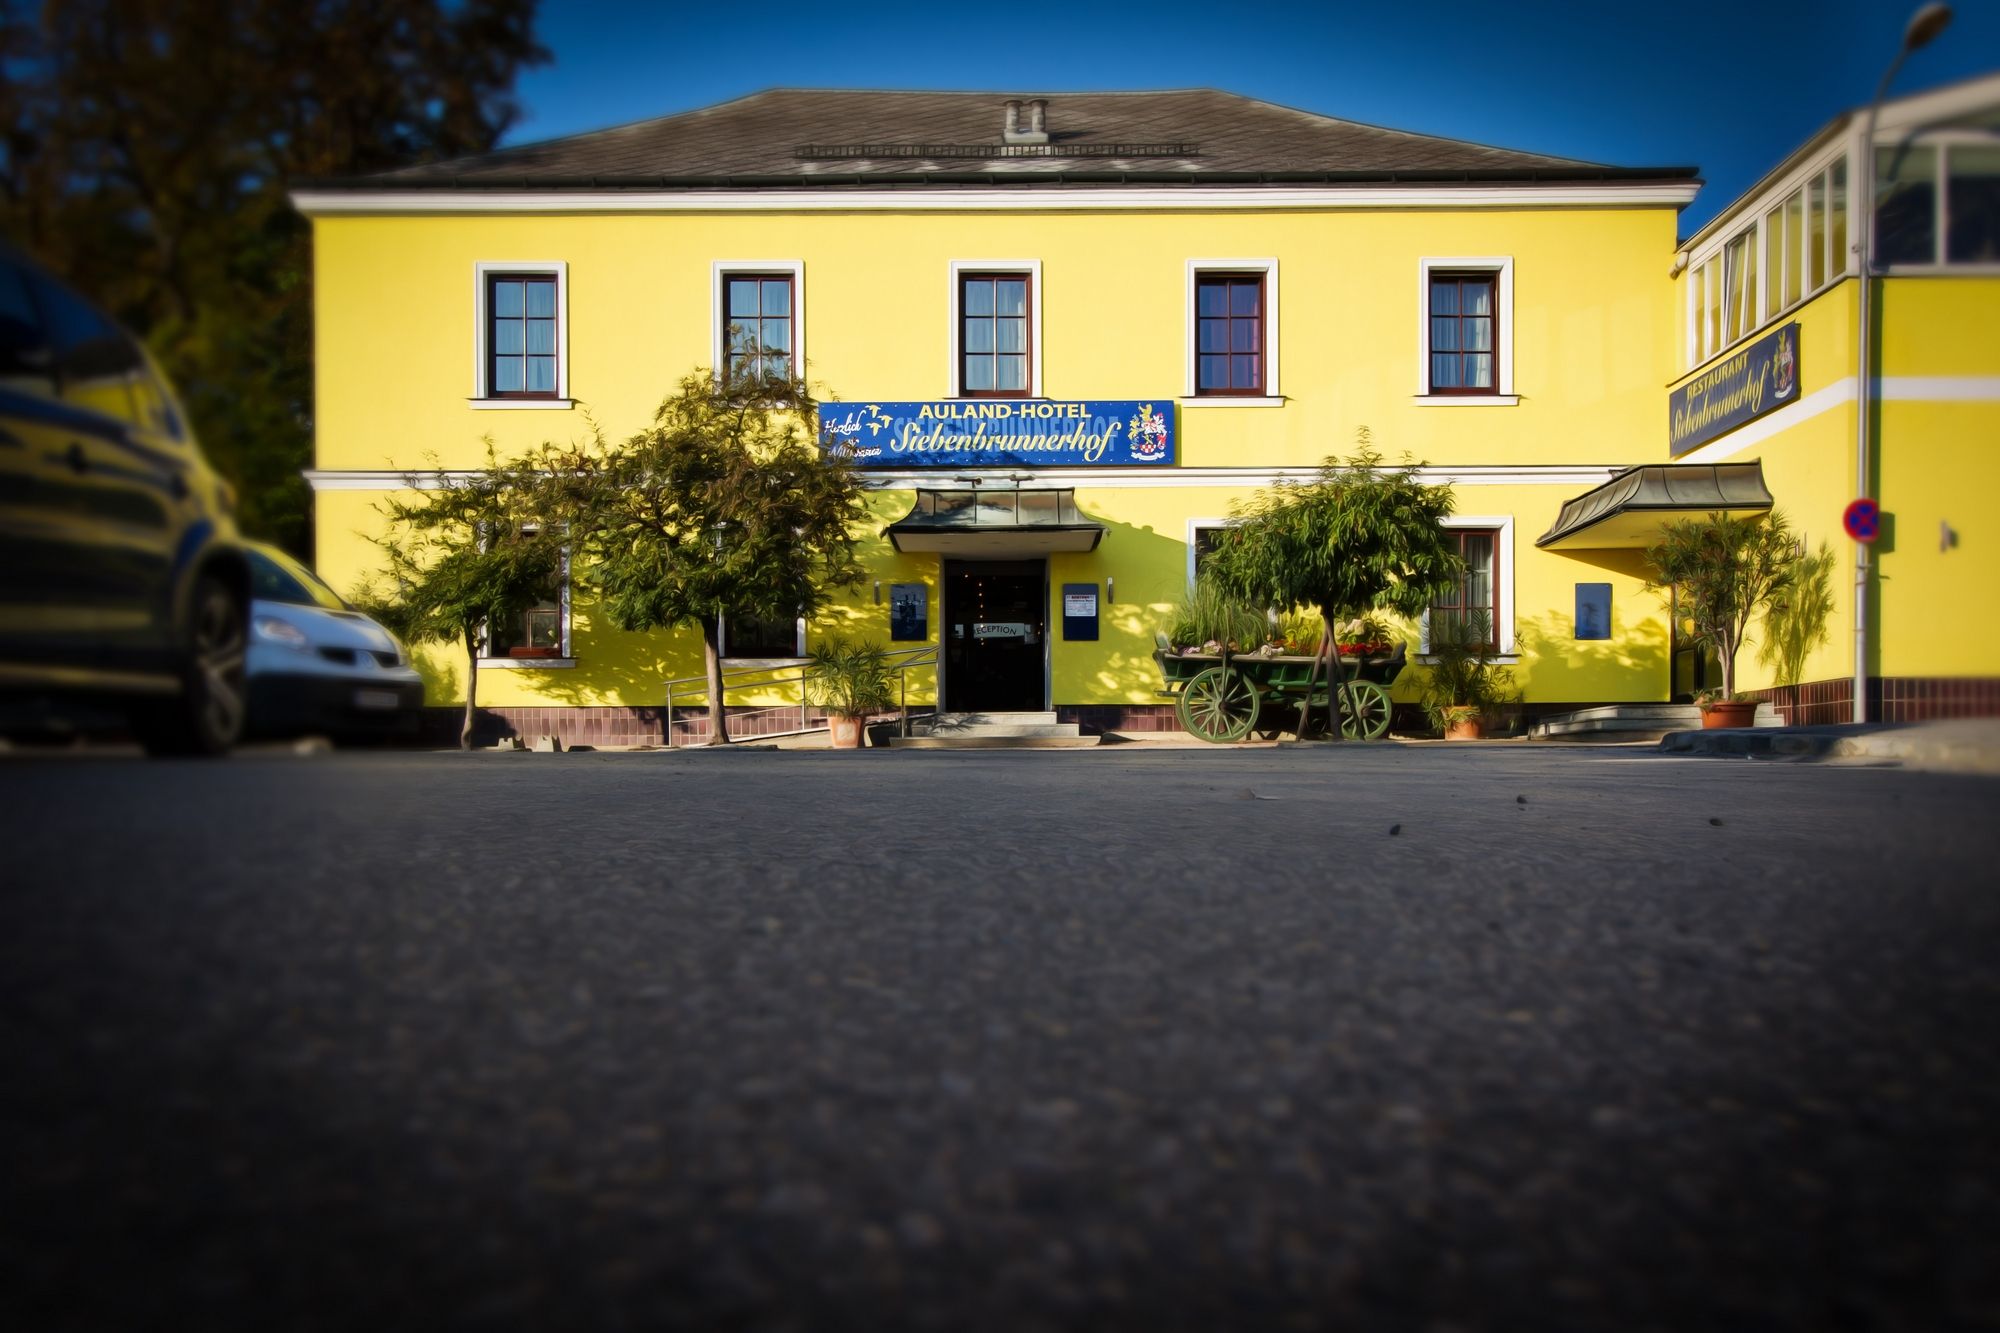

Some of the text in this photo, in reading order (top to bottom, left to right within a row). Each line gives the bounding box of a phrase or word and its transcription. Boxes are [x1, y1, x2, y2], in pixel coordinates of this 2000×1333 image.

[1686, 351, 1749, 401] RESTAURANT
[824, 410, 867, 436] Herzlich
[918, 403, 1092, 419] AULAND-HOTEL
[1670, 360, 1770, 445] Siebenbrunnerhof
[890, 421, 1122, 462] Siebenbrunnerhof
